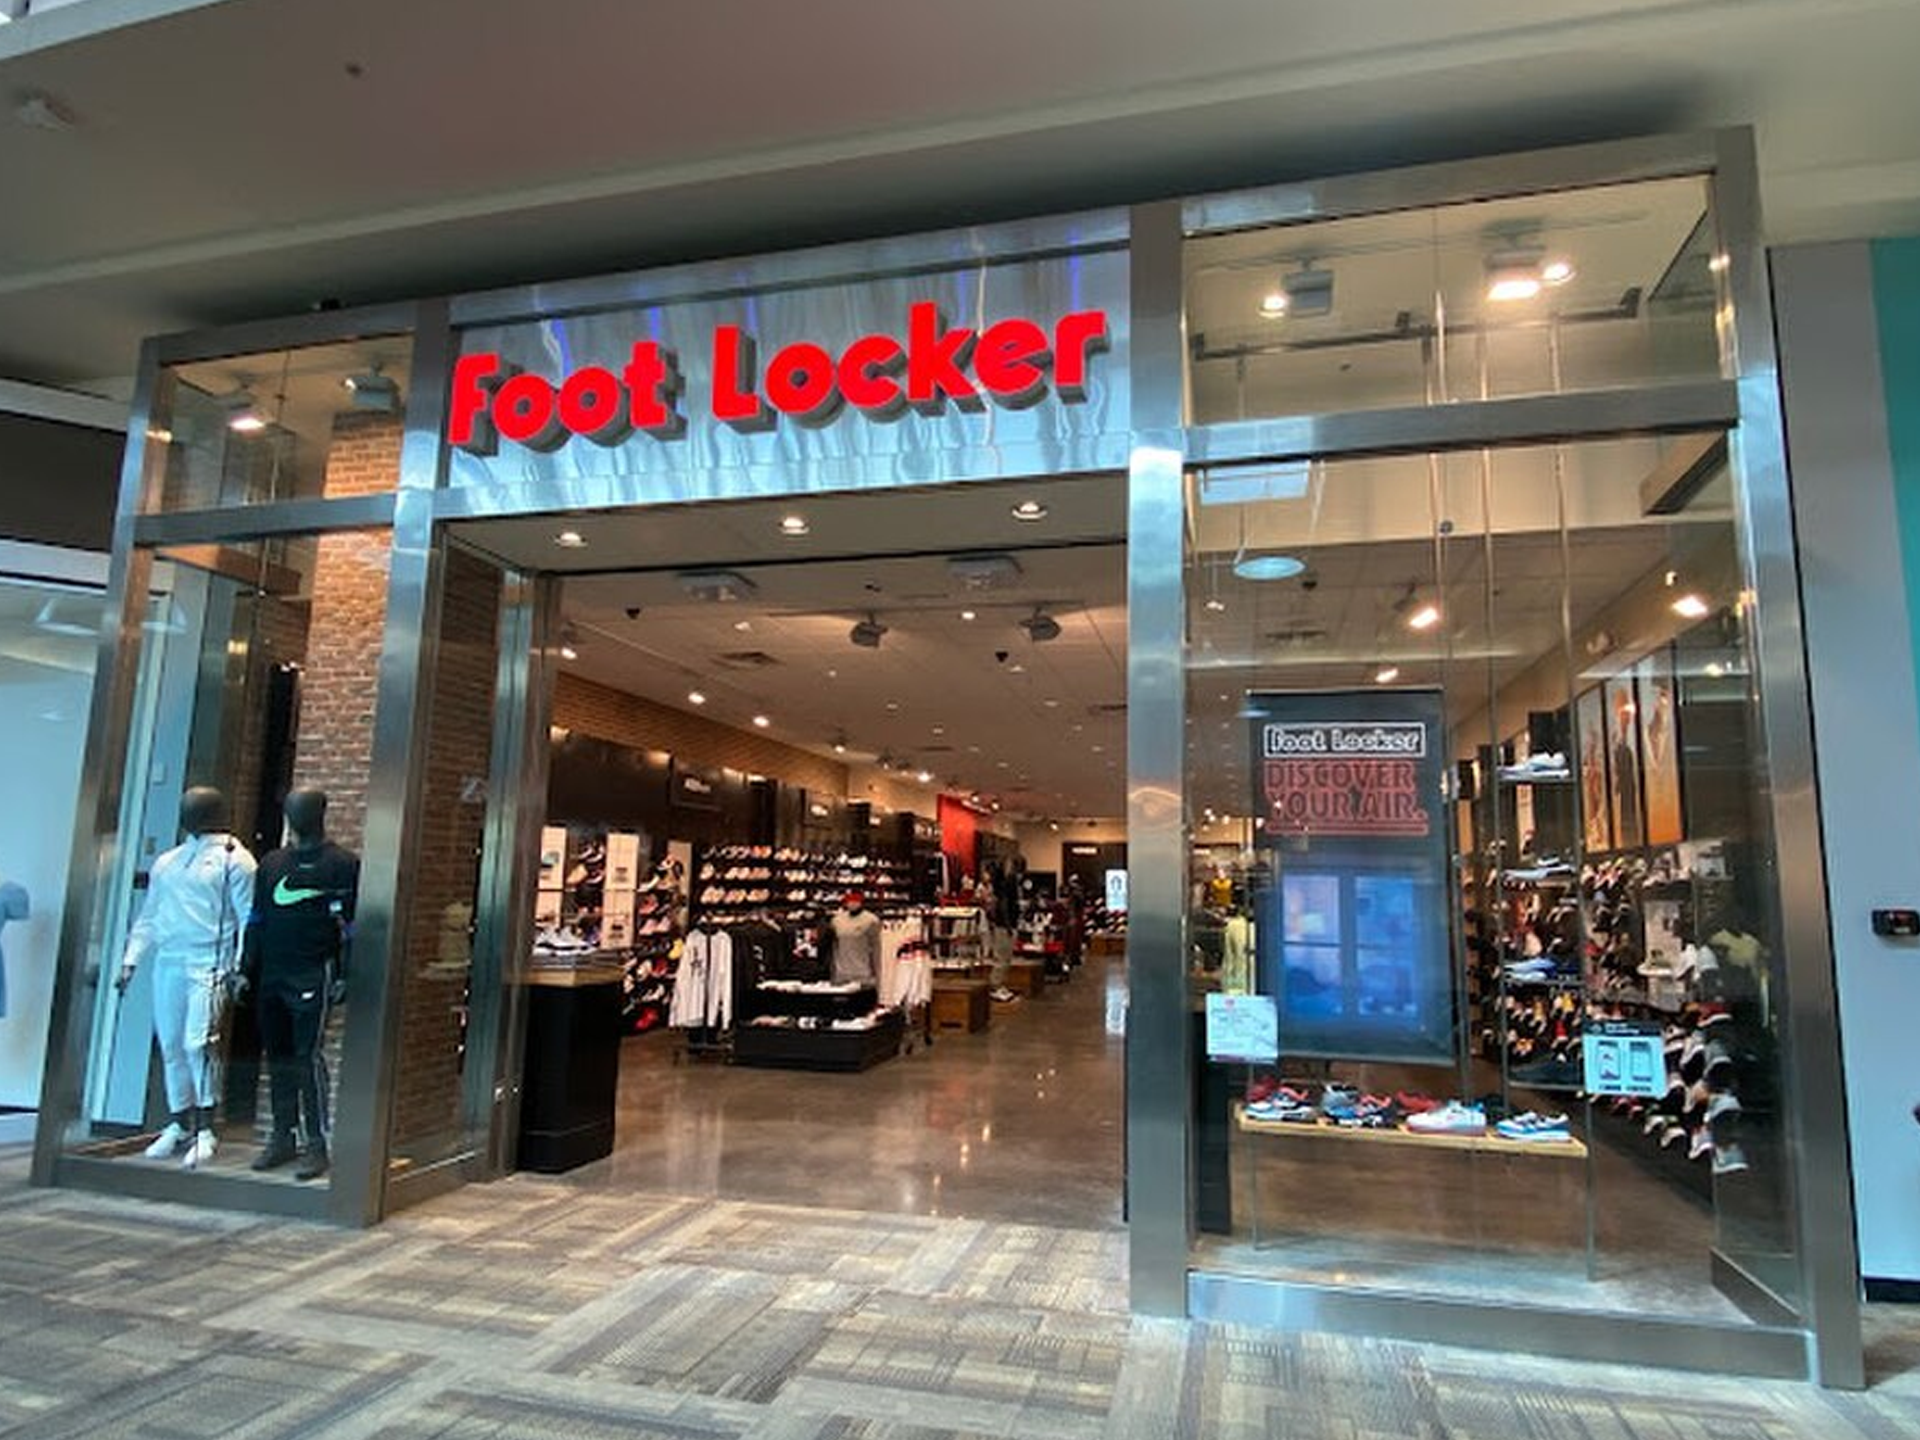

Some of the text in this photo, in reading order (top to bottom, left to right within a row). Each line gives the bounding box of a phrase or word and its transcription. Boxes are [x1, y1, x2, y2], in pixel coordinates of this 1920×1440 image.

[447, 300, 1107, 446] Foot Locker
[1331, 726, 1420, 752] Locker
[1265, 761, 1415, 790] DISCOVER
[1268, 790, 1350, 819] YOUR
